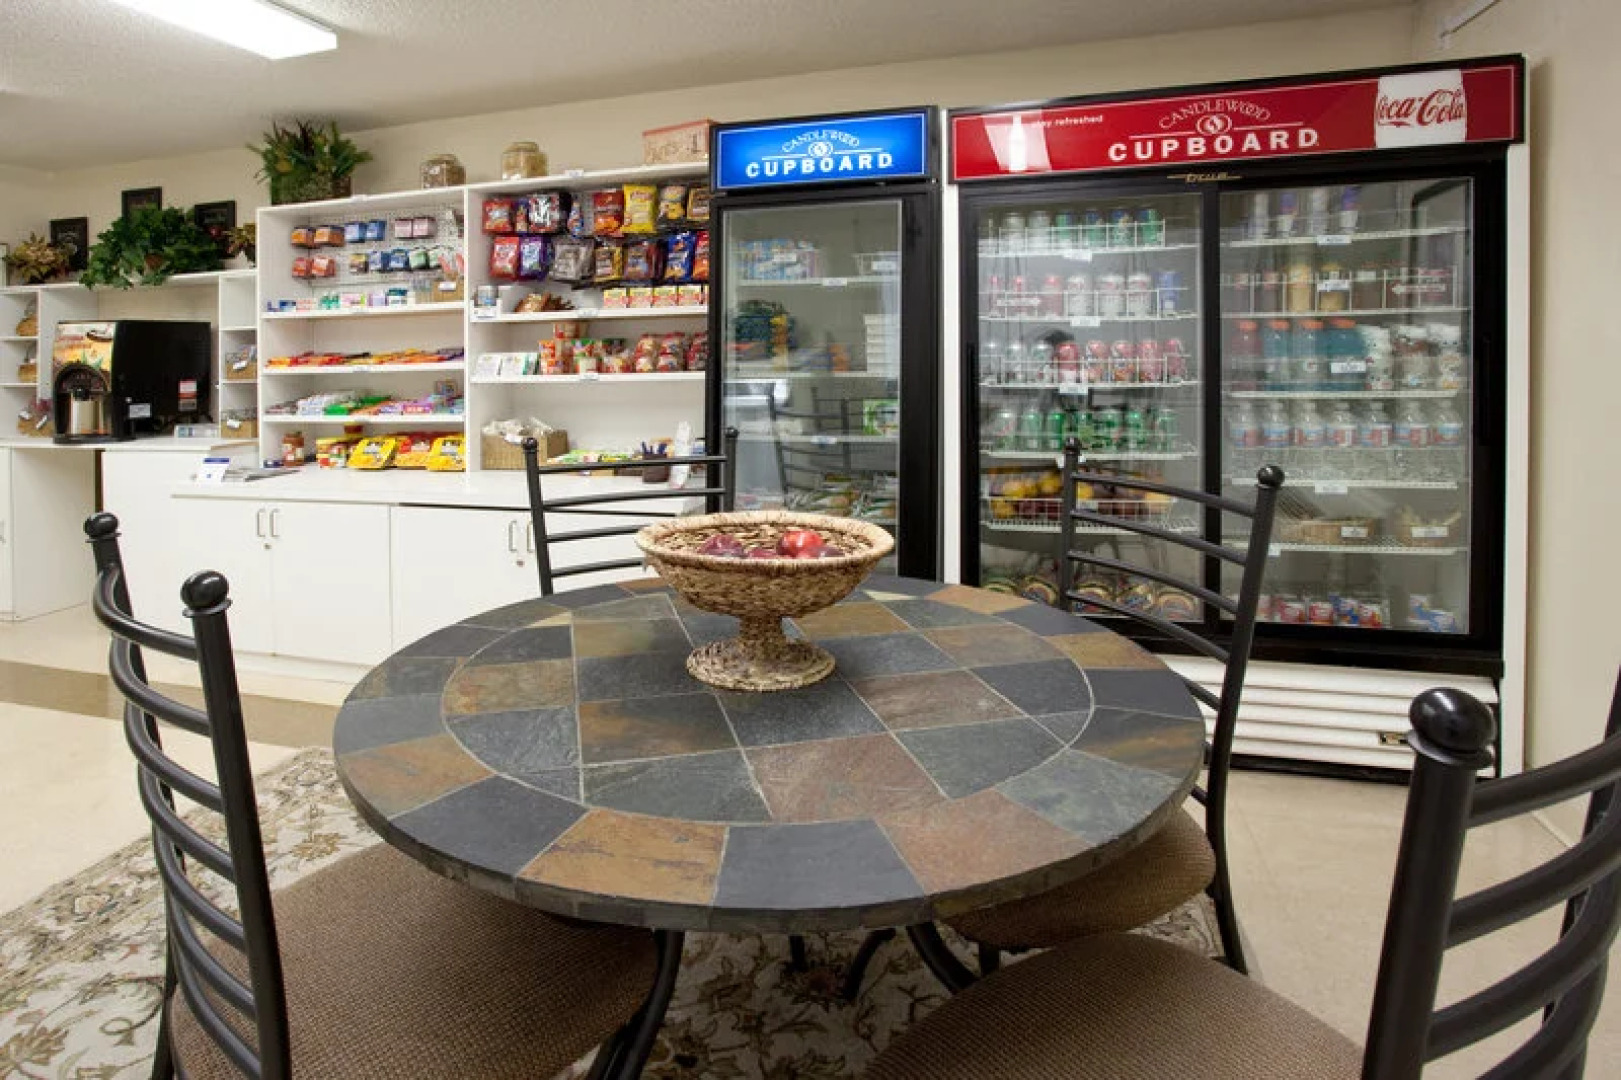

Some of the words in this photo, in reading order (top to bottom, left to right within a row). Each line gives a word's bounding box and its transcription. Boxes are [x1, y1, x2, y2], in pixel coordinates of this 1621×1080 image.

[1055, 115, 1103, 127] refreshed
[1159, 99, 1271, 129] CANDLEWOOD
[1377, 89, 1464, 127] oca-Cola
[781, 129, 860, 153] CANDLEWOOD
[1108, 128, 1319, 161] CUPBOARD
[745, 153, 893, 178] CUPBOARD
